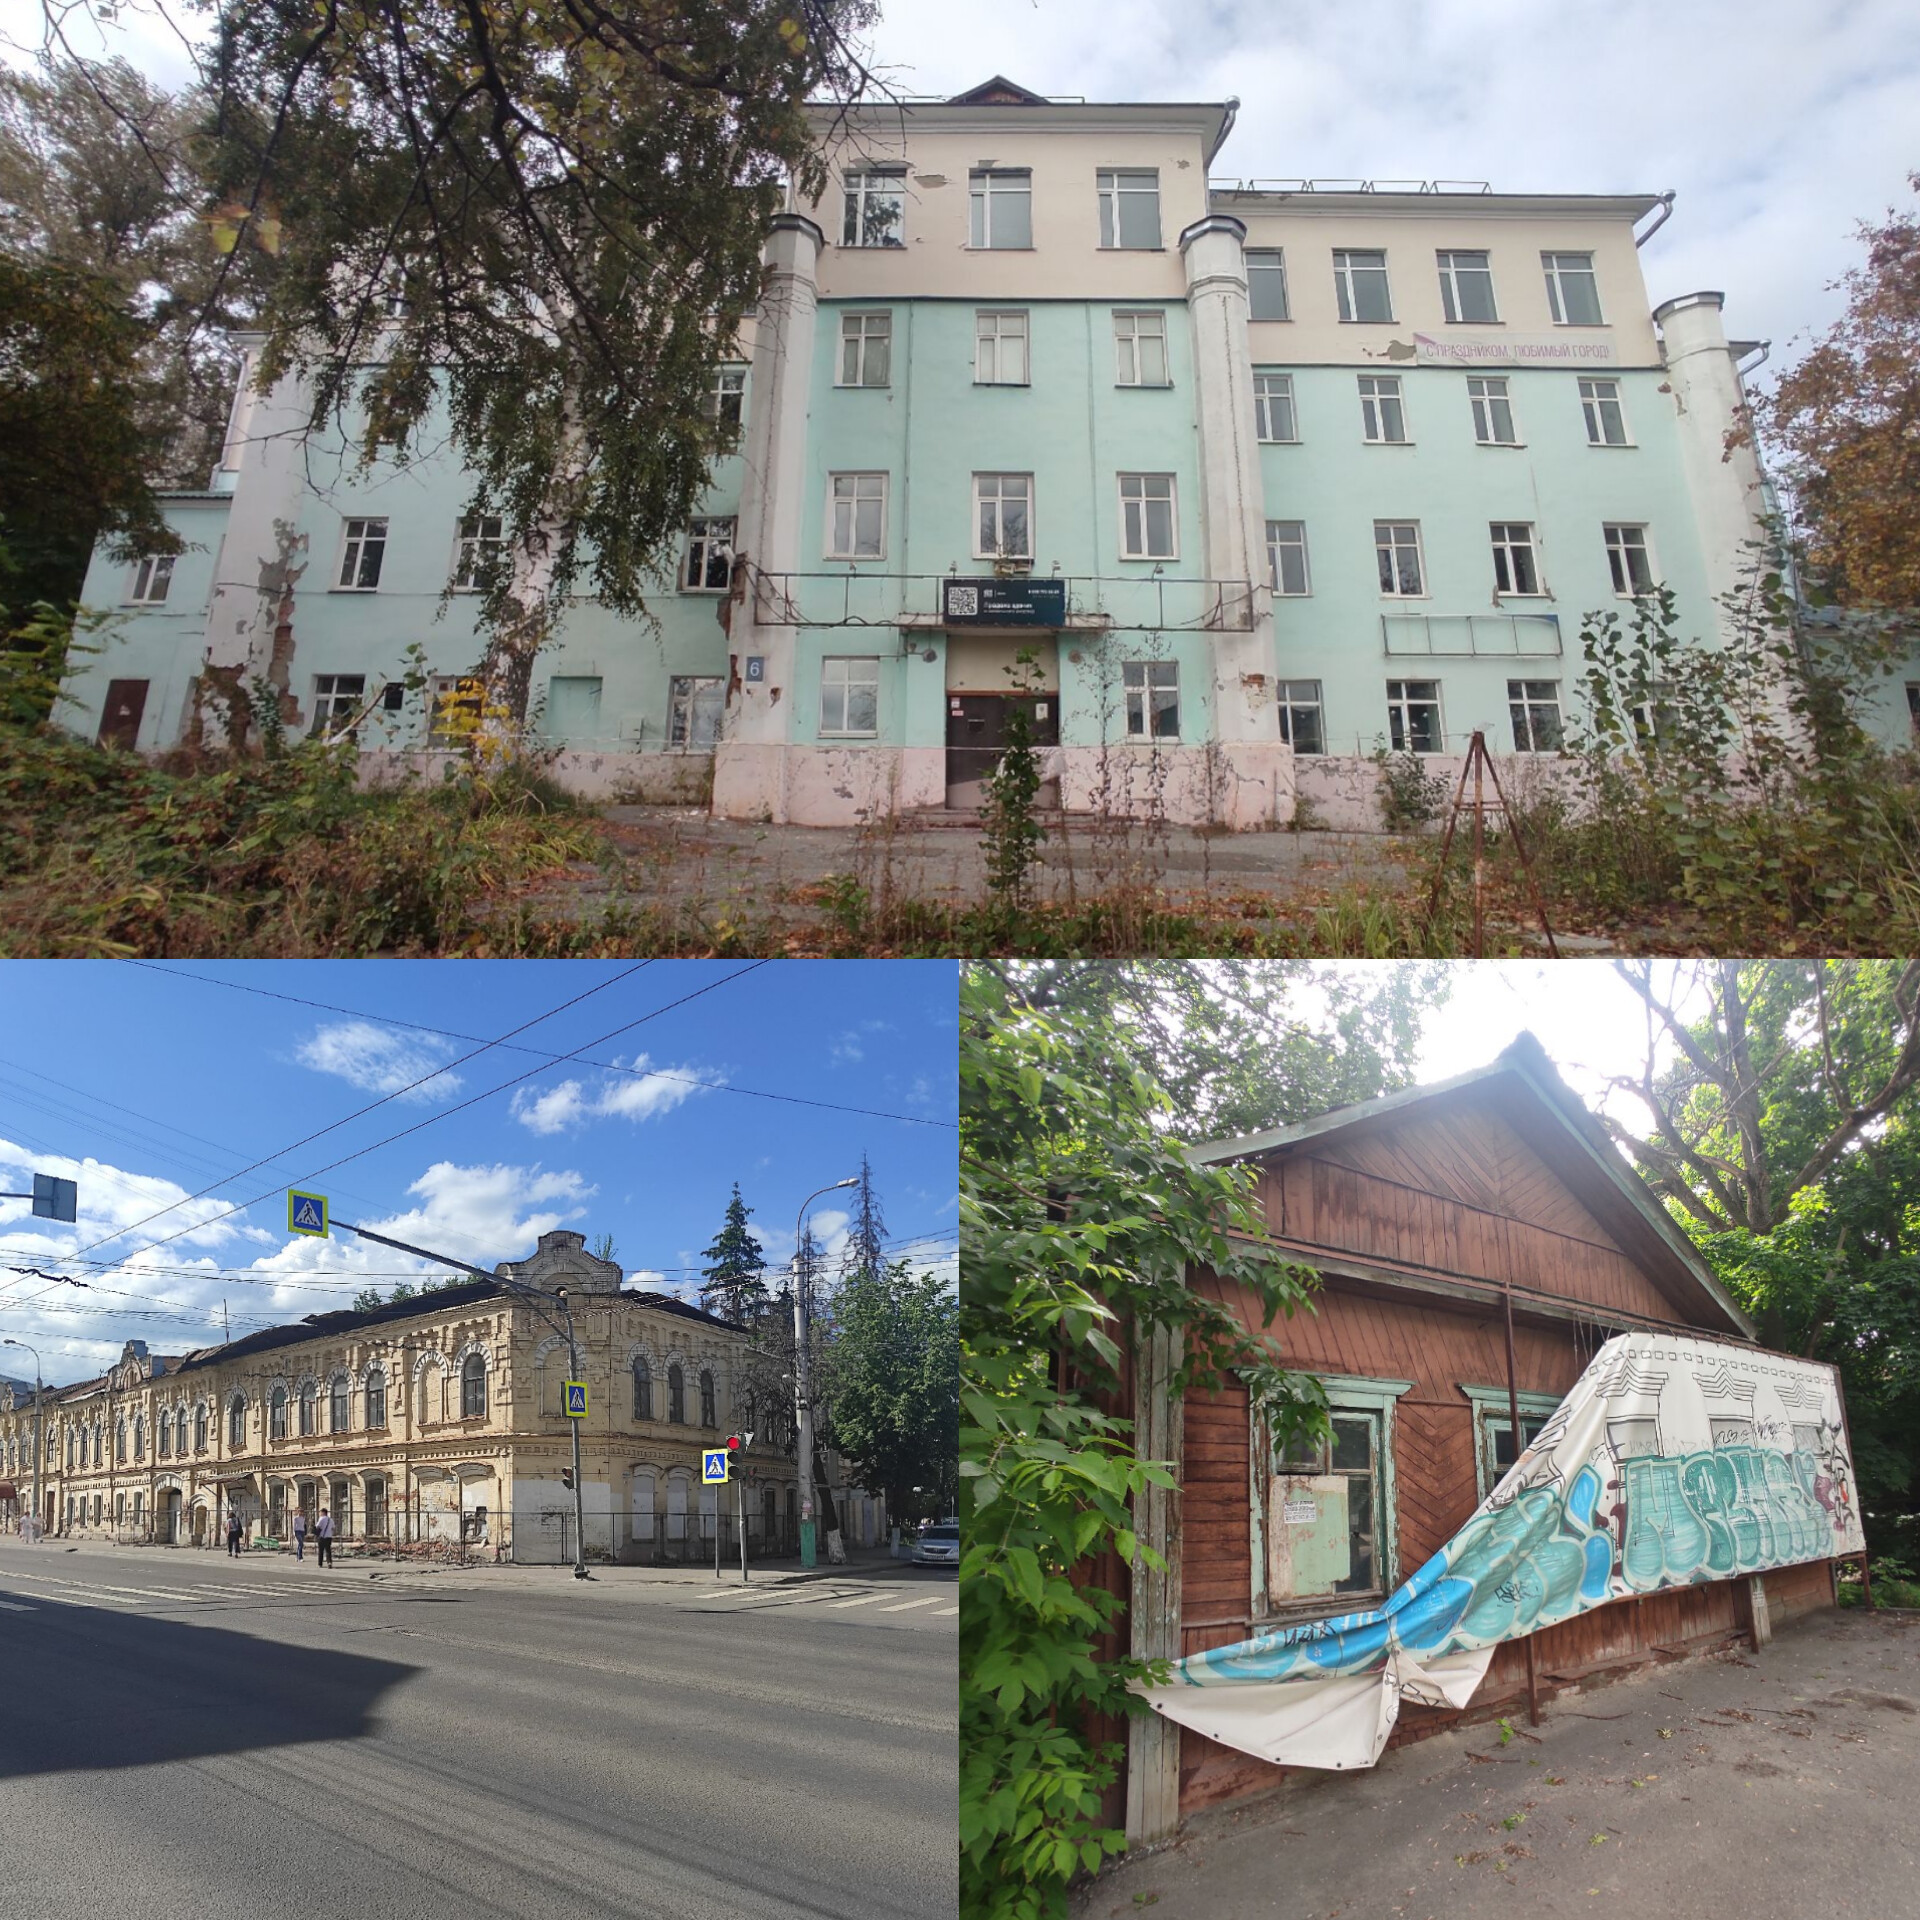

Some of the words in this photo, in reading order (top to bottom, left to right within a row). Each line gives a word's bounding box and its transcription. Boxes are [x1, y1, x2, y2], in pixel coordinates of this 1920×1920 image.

[1426, 343, 1434, 357] С
[1437, 344, 1512, 358] ПРАЗДНИКОМ,
[1514, 342, 1571, 357] ЛЮБИМЫЙ
[1572, 344, 1609, 359] ГОРОД!
[750, 662, 760, 676] 6
